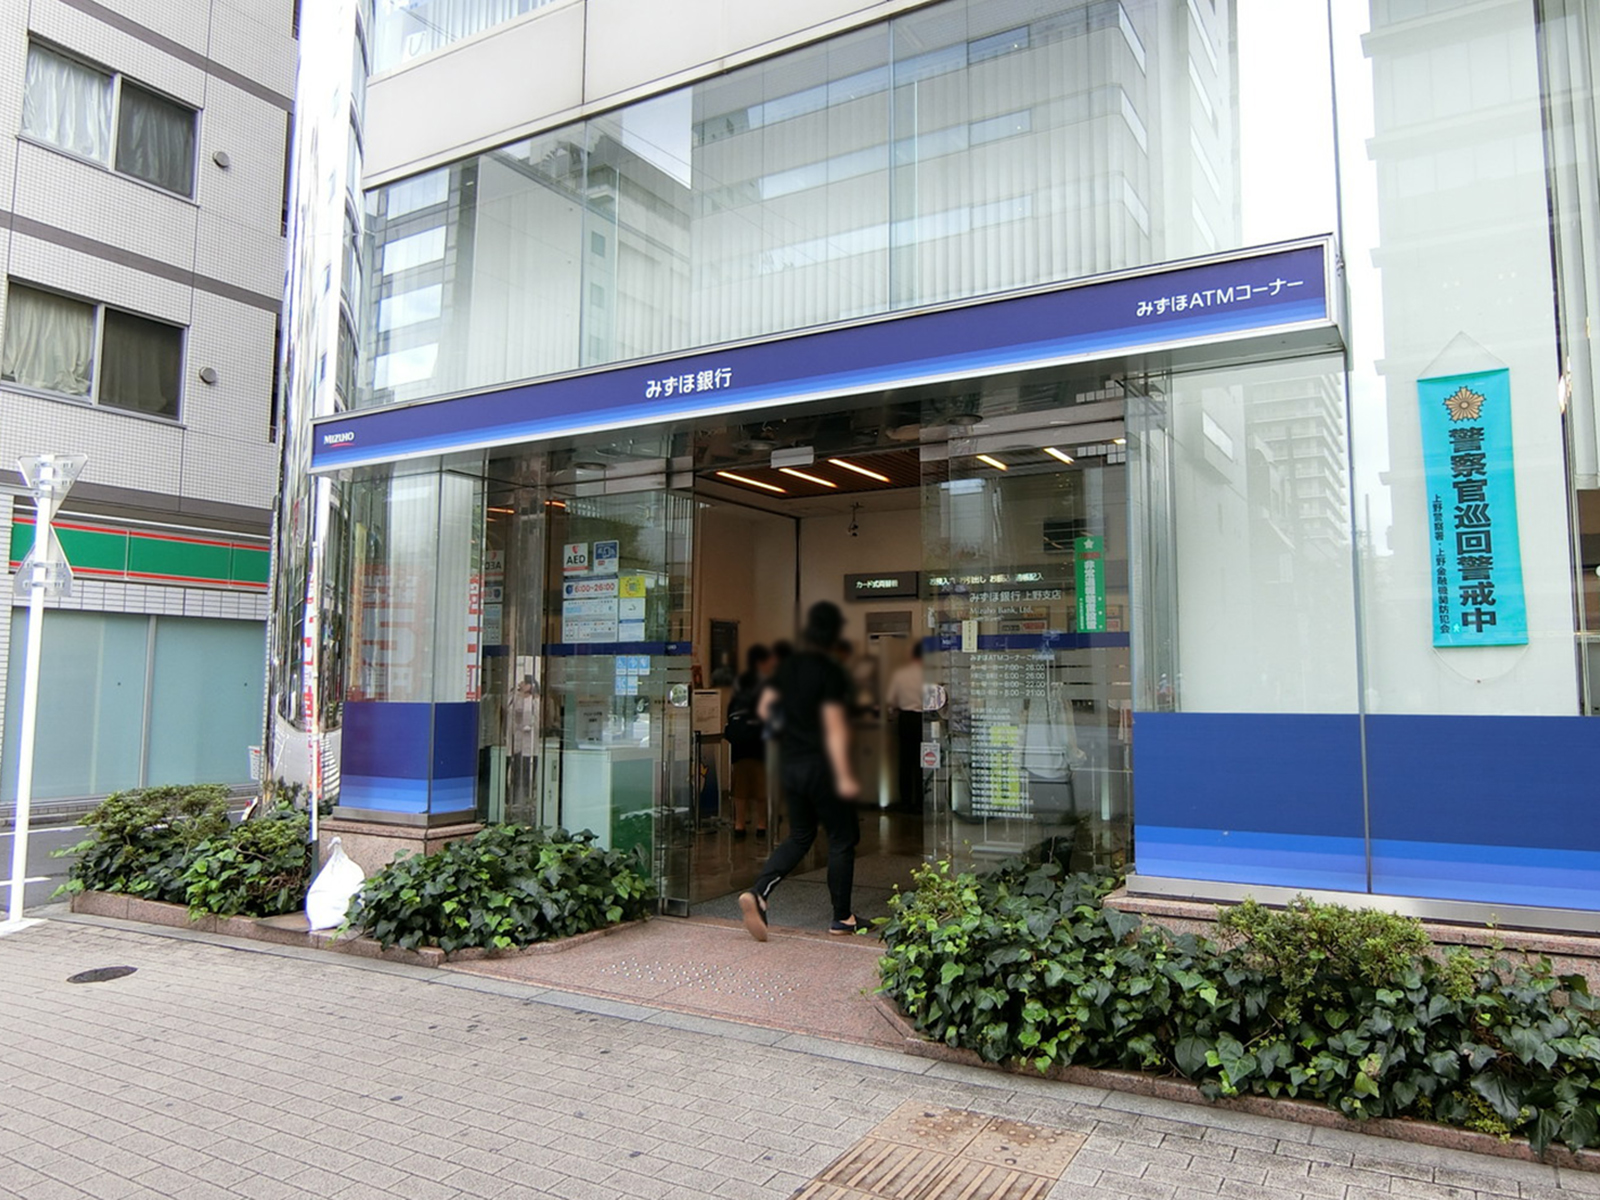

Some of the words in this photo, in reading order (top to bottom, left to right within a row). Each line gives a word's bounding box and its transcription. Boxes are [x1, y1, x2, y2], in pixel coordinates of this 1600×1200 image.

[1136, 278, 1304, 317] みずほATMコーナー
[645, 367, 733, 398] みずほ銀行
[323, 431, 355, 445] MIZUHO
[1448, 426, 1497, 633] 警察官巡回警戒中
[566, 555, 586, 565] AED
[969, 591, 1020, 603] みずほ銀行
[1022, 589, 1062, 601] 上野支店
